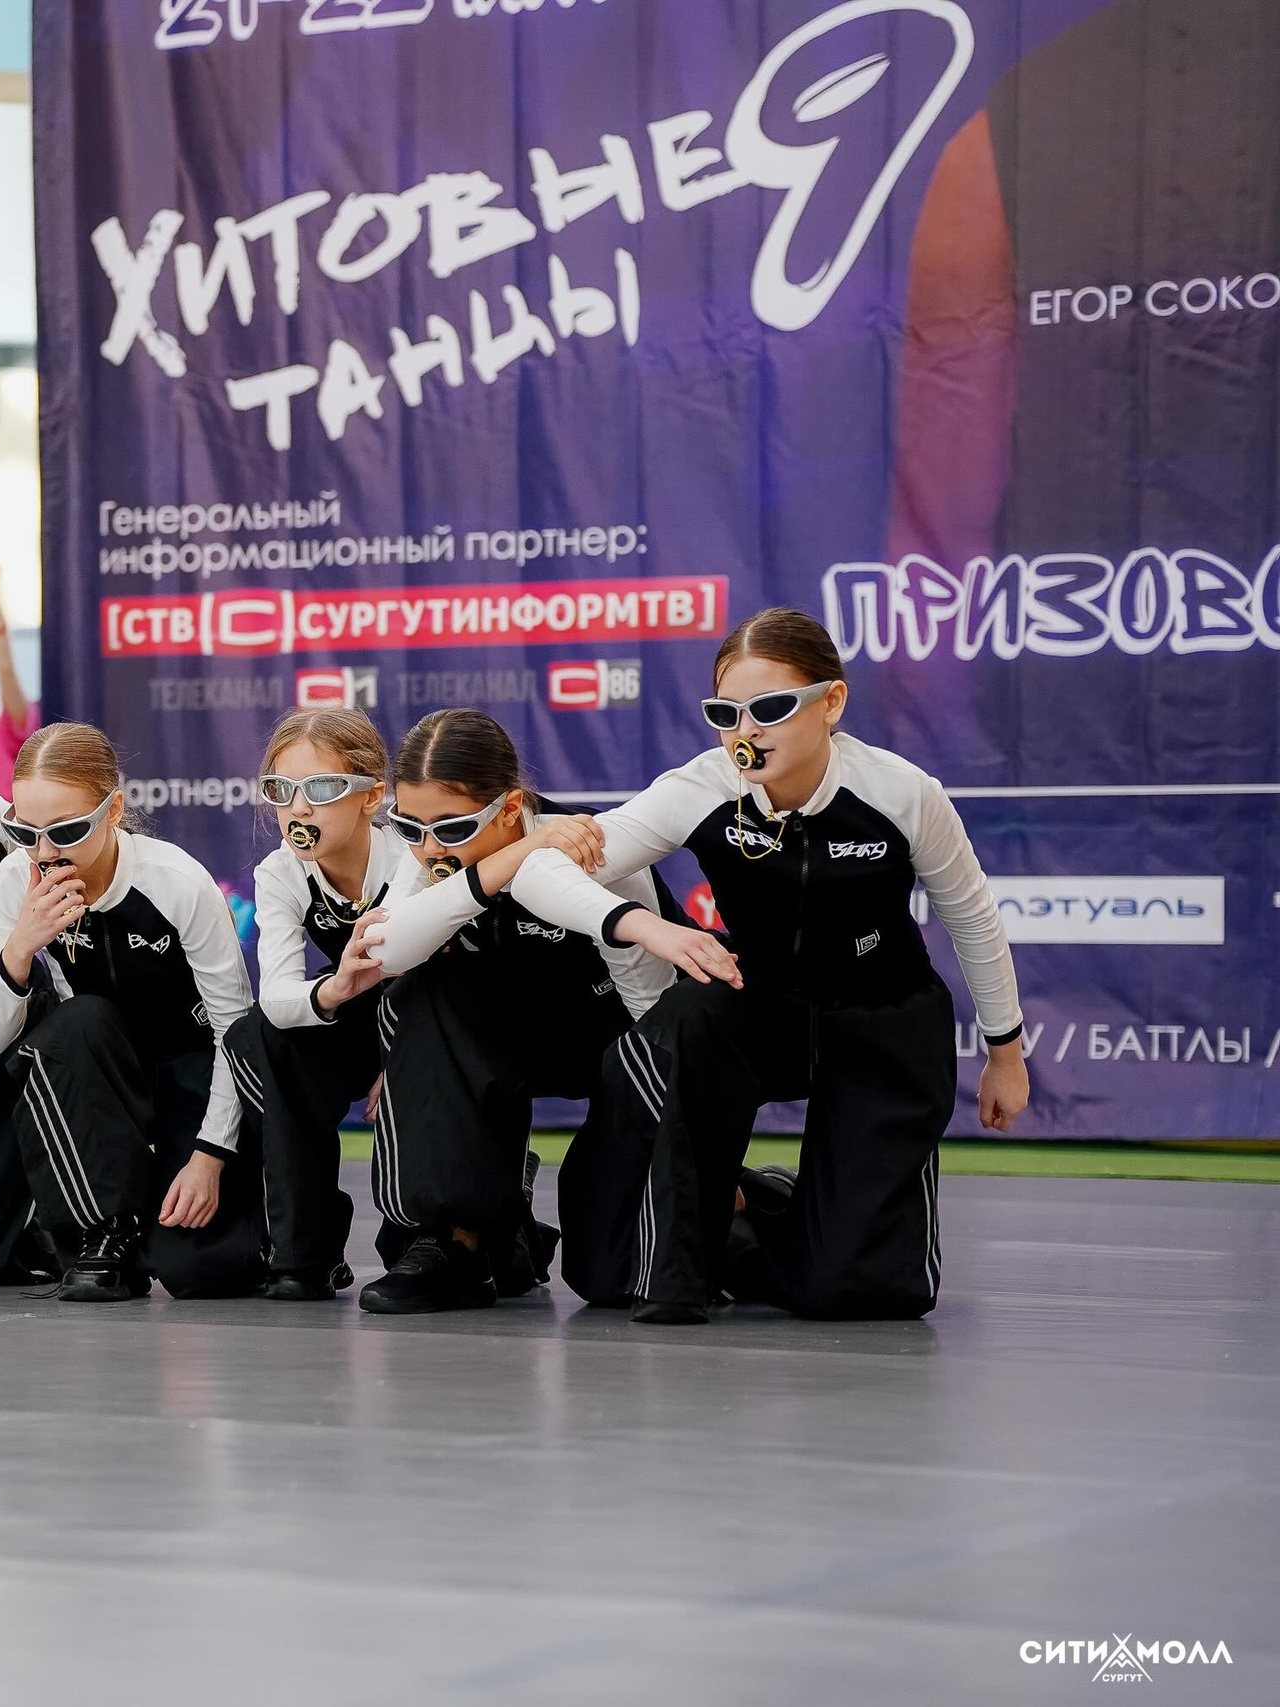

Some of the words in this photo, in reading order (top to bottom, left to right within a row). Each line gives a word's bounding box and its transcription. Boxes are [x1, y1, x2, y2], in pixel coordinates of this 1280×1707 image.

[91, 110, 738, 378] ХИТОВЫЕ
[1029, 284, 1134, 326] ЕГОР
[1145, 272, 1280, 317] СОКО
[224, 248, 640, 451] ТАНЦЫ
[99, 489, 341, 541] Генеральный
[99, 524, 455, 582] информационный
[464, 524, 648, 568] партнер:
[118, 770, 266, 814] артнер
[956, 1020, 1045, 1059] ШУ
[1087, 1023, 1251, 1063] БАТТЛЫ
